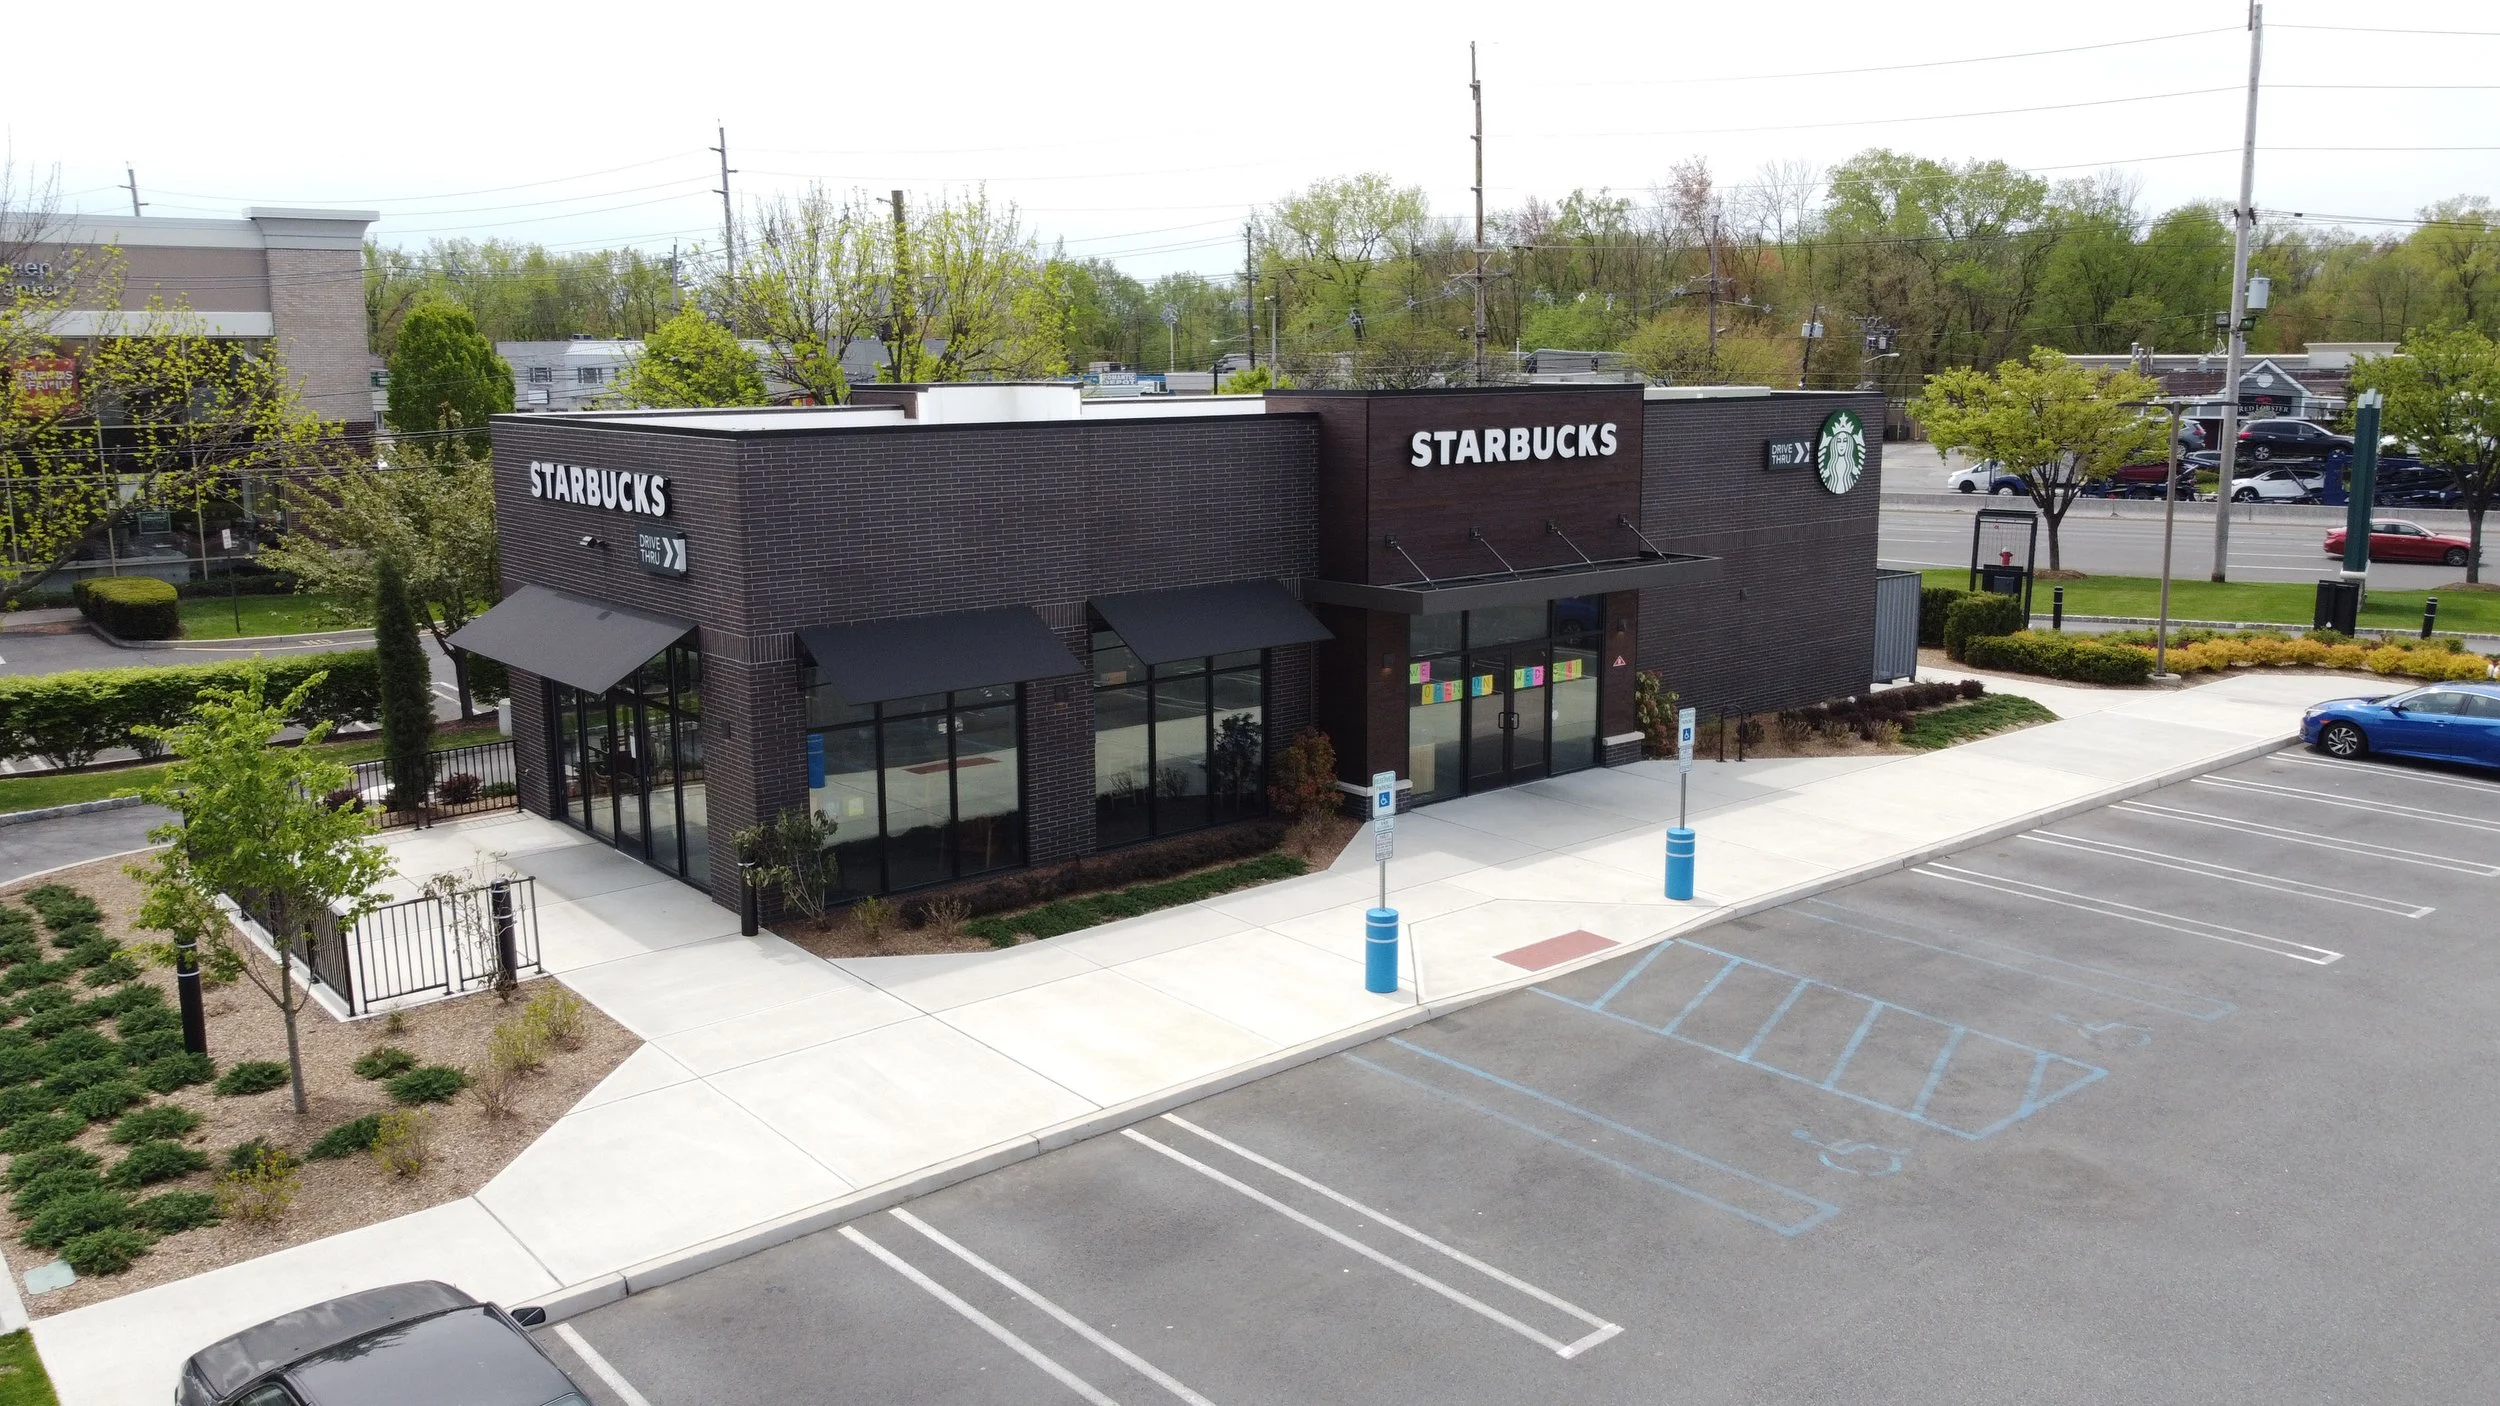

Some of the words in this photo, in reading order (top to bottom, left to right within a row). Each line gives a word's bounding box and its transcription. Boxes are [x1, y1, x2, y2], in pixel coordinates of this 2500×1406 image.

[2256, 404, 2289, 412] LOBSTER
[1411, 422, 1618, 468] STARBUCKS
[1772, 443, 1793, 455] DRIVE
[1772, 454, 1792, 465] THRU
[530, 460, 667, 517] STARBUCKS
[639, 533, 661, 550] DRIVE
[640, 549, 661, 565] THRU
[1423, 682, 1462, 699] OPEN
